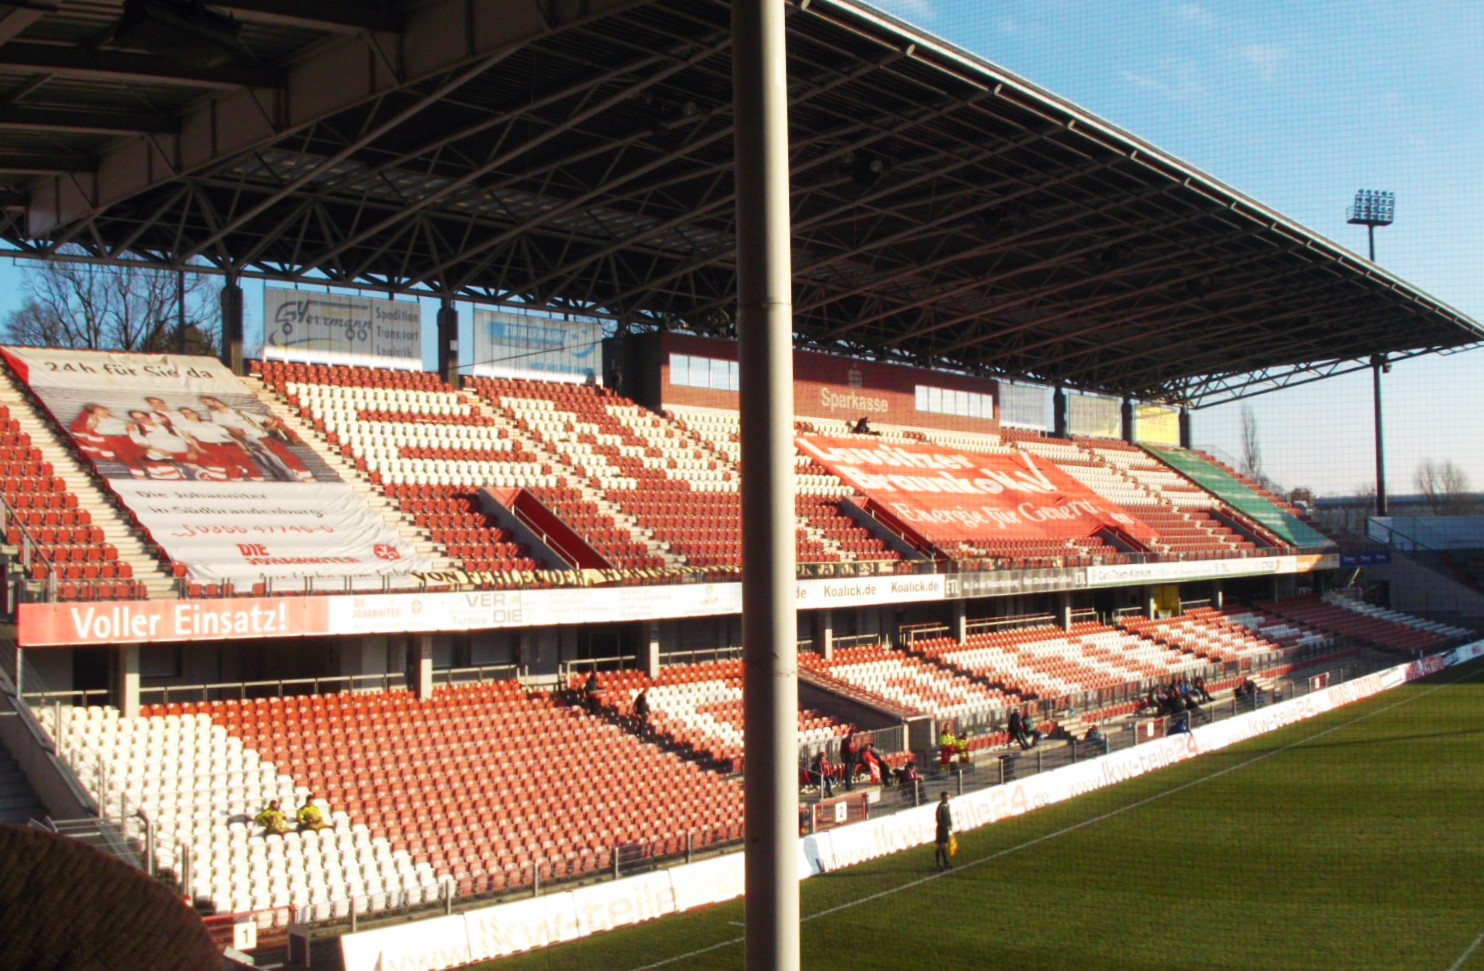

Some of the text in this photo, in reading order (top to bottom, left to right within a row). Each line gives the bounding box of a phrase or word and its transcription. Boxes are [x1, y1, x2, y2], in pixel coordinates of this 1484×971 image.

[375, 306, 419, 323] Spedition
[375, 325, 419, 342] Transport
[104, 362, 138, 377] für
[143, 365, 180, 378] Sie
[186, 367, 214, 379] da
[820, 387, 889, 413] Sparkasse
[795, 438, 976, 471] Lausitzer
[174, 490, 268, 501] Johanniter
[890, 502, 983, 526] Energie
[987, 504, 1020, 529] für
[236, 543, 270, 557] DIE
[245, 557, 362, 566] JOHANNITER
[411, 570, 462, 584] VON
[823, 585, 877, 598] Koalick.de
[890, 581, 940, 594] Koalick.de
[465, 593, 506, 608] VER
[70, 602, 287, 640] Voller Einsatz!
[451, 615, 488, 625] Turnow
[492, 609, 523, 624] DIE
